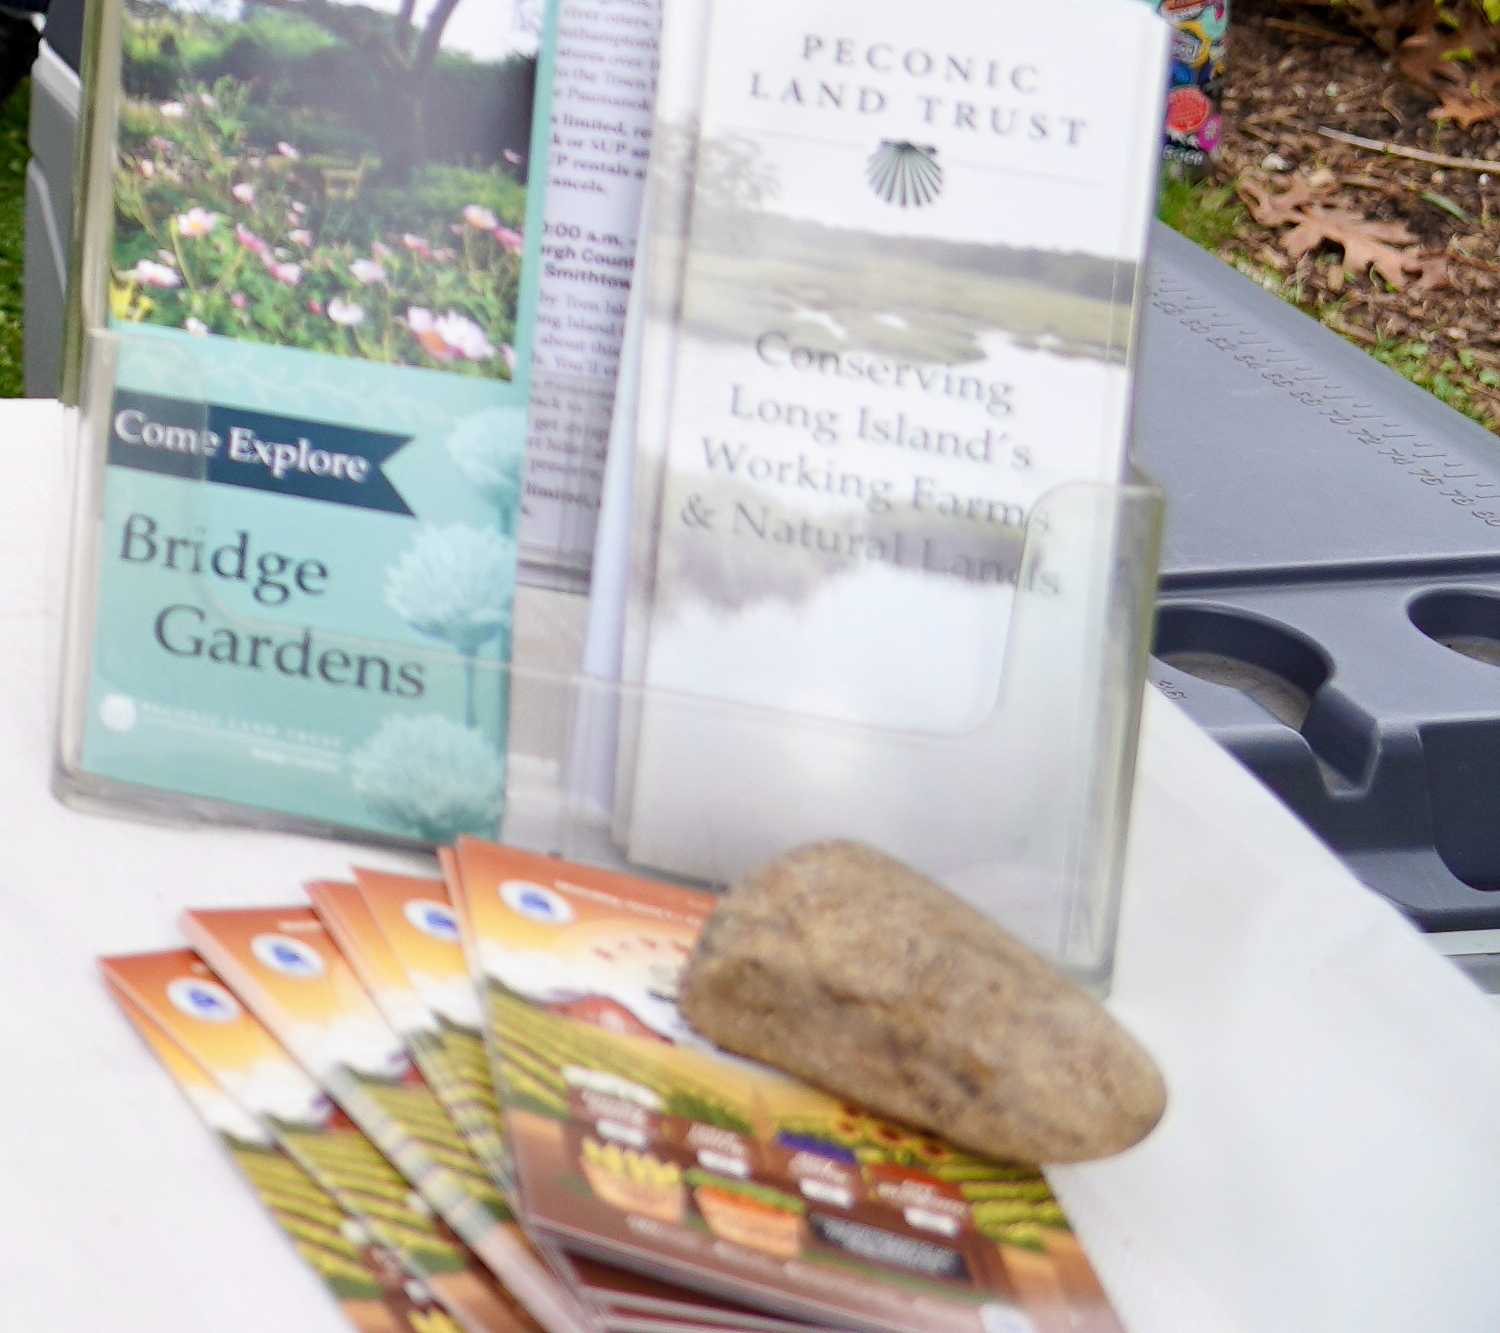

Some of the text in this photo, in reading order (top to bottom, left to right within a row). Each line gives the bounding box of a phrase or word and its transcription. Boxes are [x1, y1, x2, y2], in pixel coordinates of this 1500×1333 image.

[802, 32, 1041, 95] PECONIC
[749, 70, 1088, 148] LAND TRUST
[754, 330, 1015, 418] Conserving
[114, 407, 371, 484] Come Explore
[729, 382, 1034, 471] Long Island's
[701, 436, 1051, 534] Working Farms
[119, 512, 329, 608] Bridge
[679, 496, 1062, 597] & Natural Lands
[153, 603, 426, 700] Gardens
